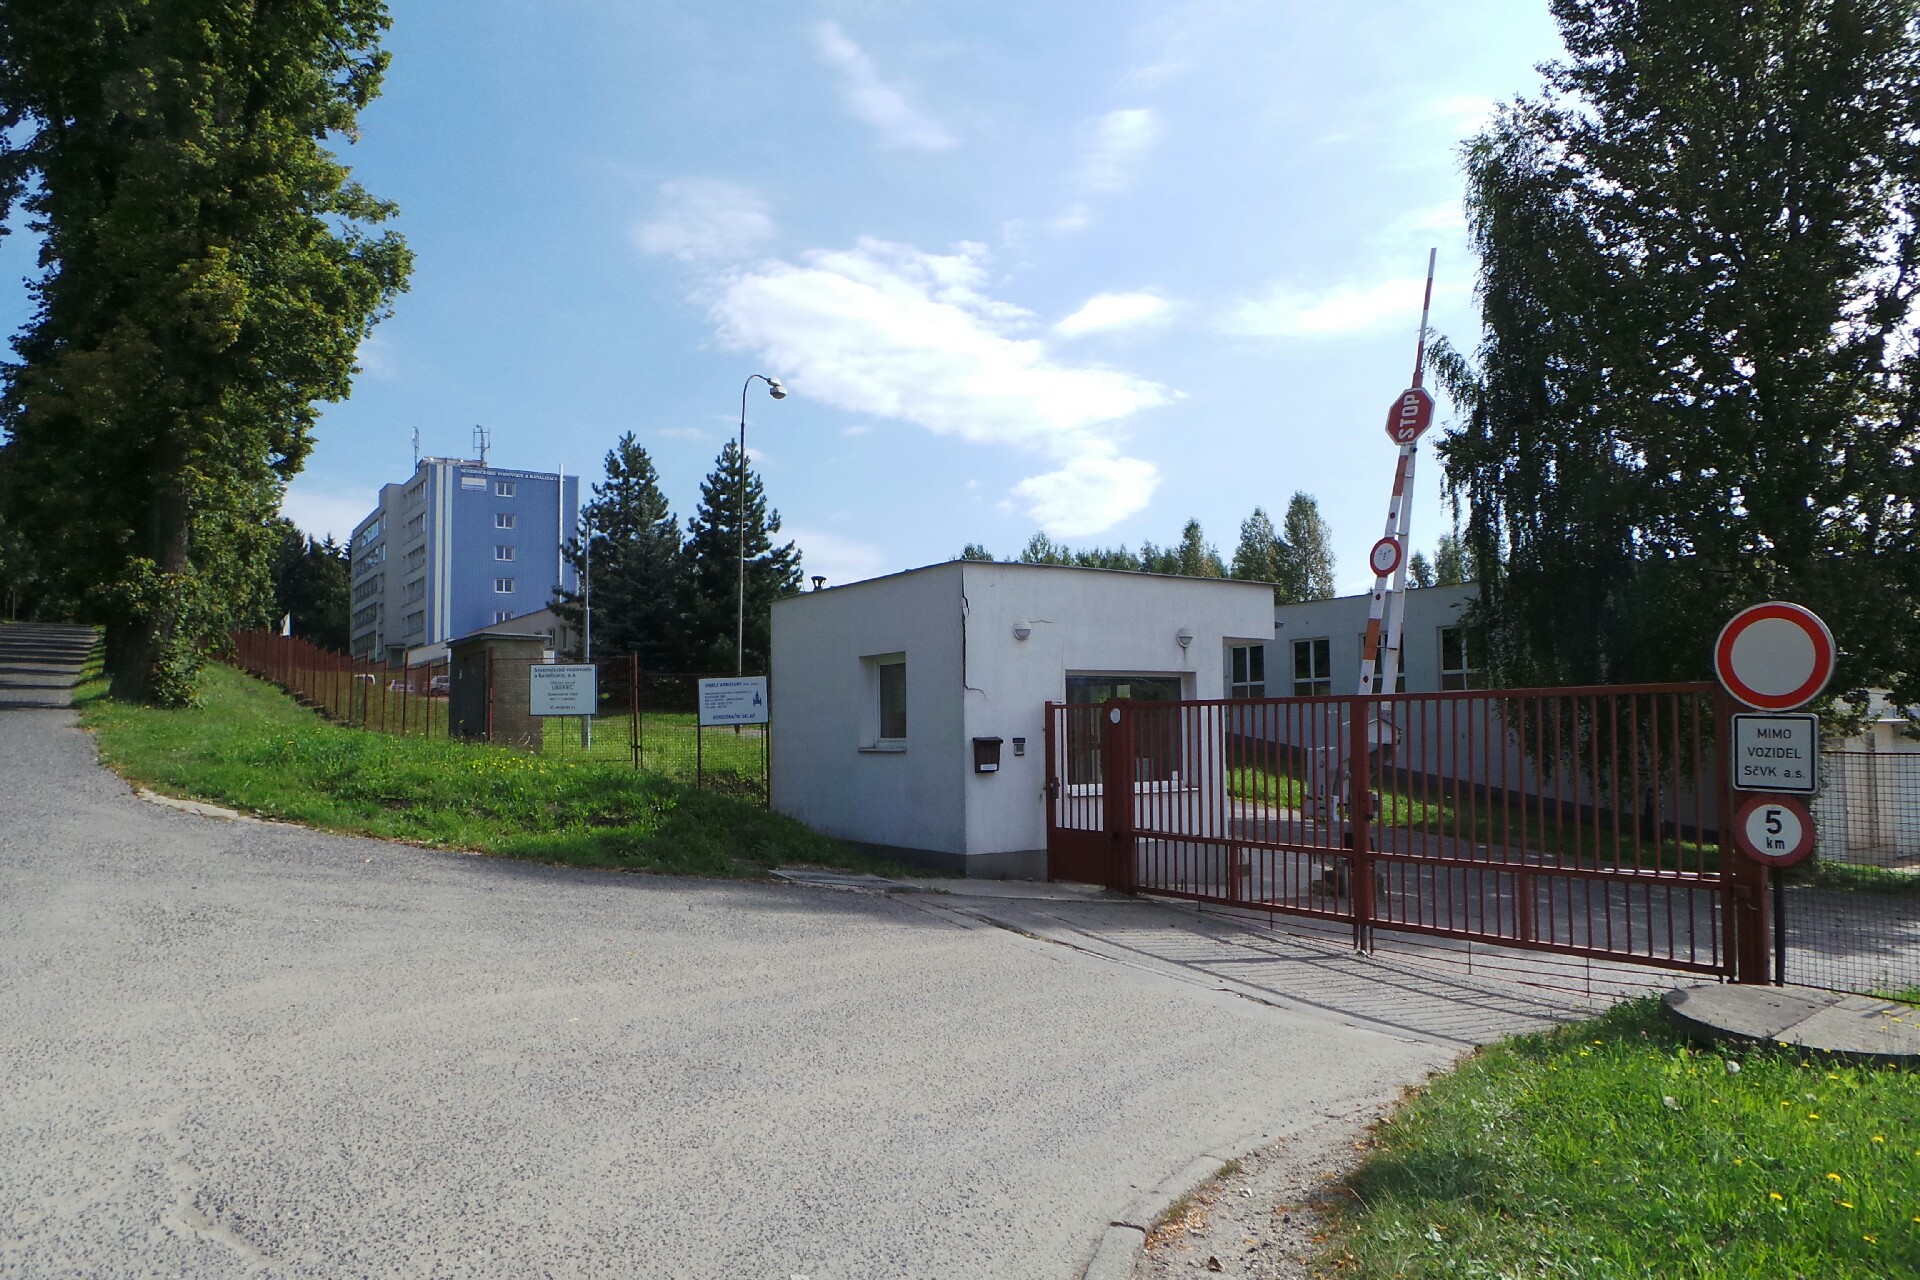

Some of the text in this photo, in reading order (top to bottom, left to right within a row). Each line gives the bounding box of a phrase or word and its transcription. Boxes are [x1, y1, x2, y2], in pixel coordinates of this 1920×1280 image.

[1398, 394, 1420, 439] STOP
[1757, 728, 1792, 739] MIMO
[1747, 747, 1802, 759] VOZIDEL
[1784, 769, 1806, 779] a.s.
[1765, 810, 1783, 835] 5
[1766, 837, 1786, 850] km
